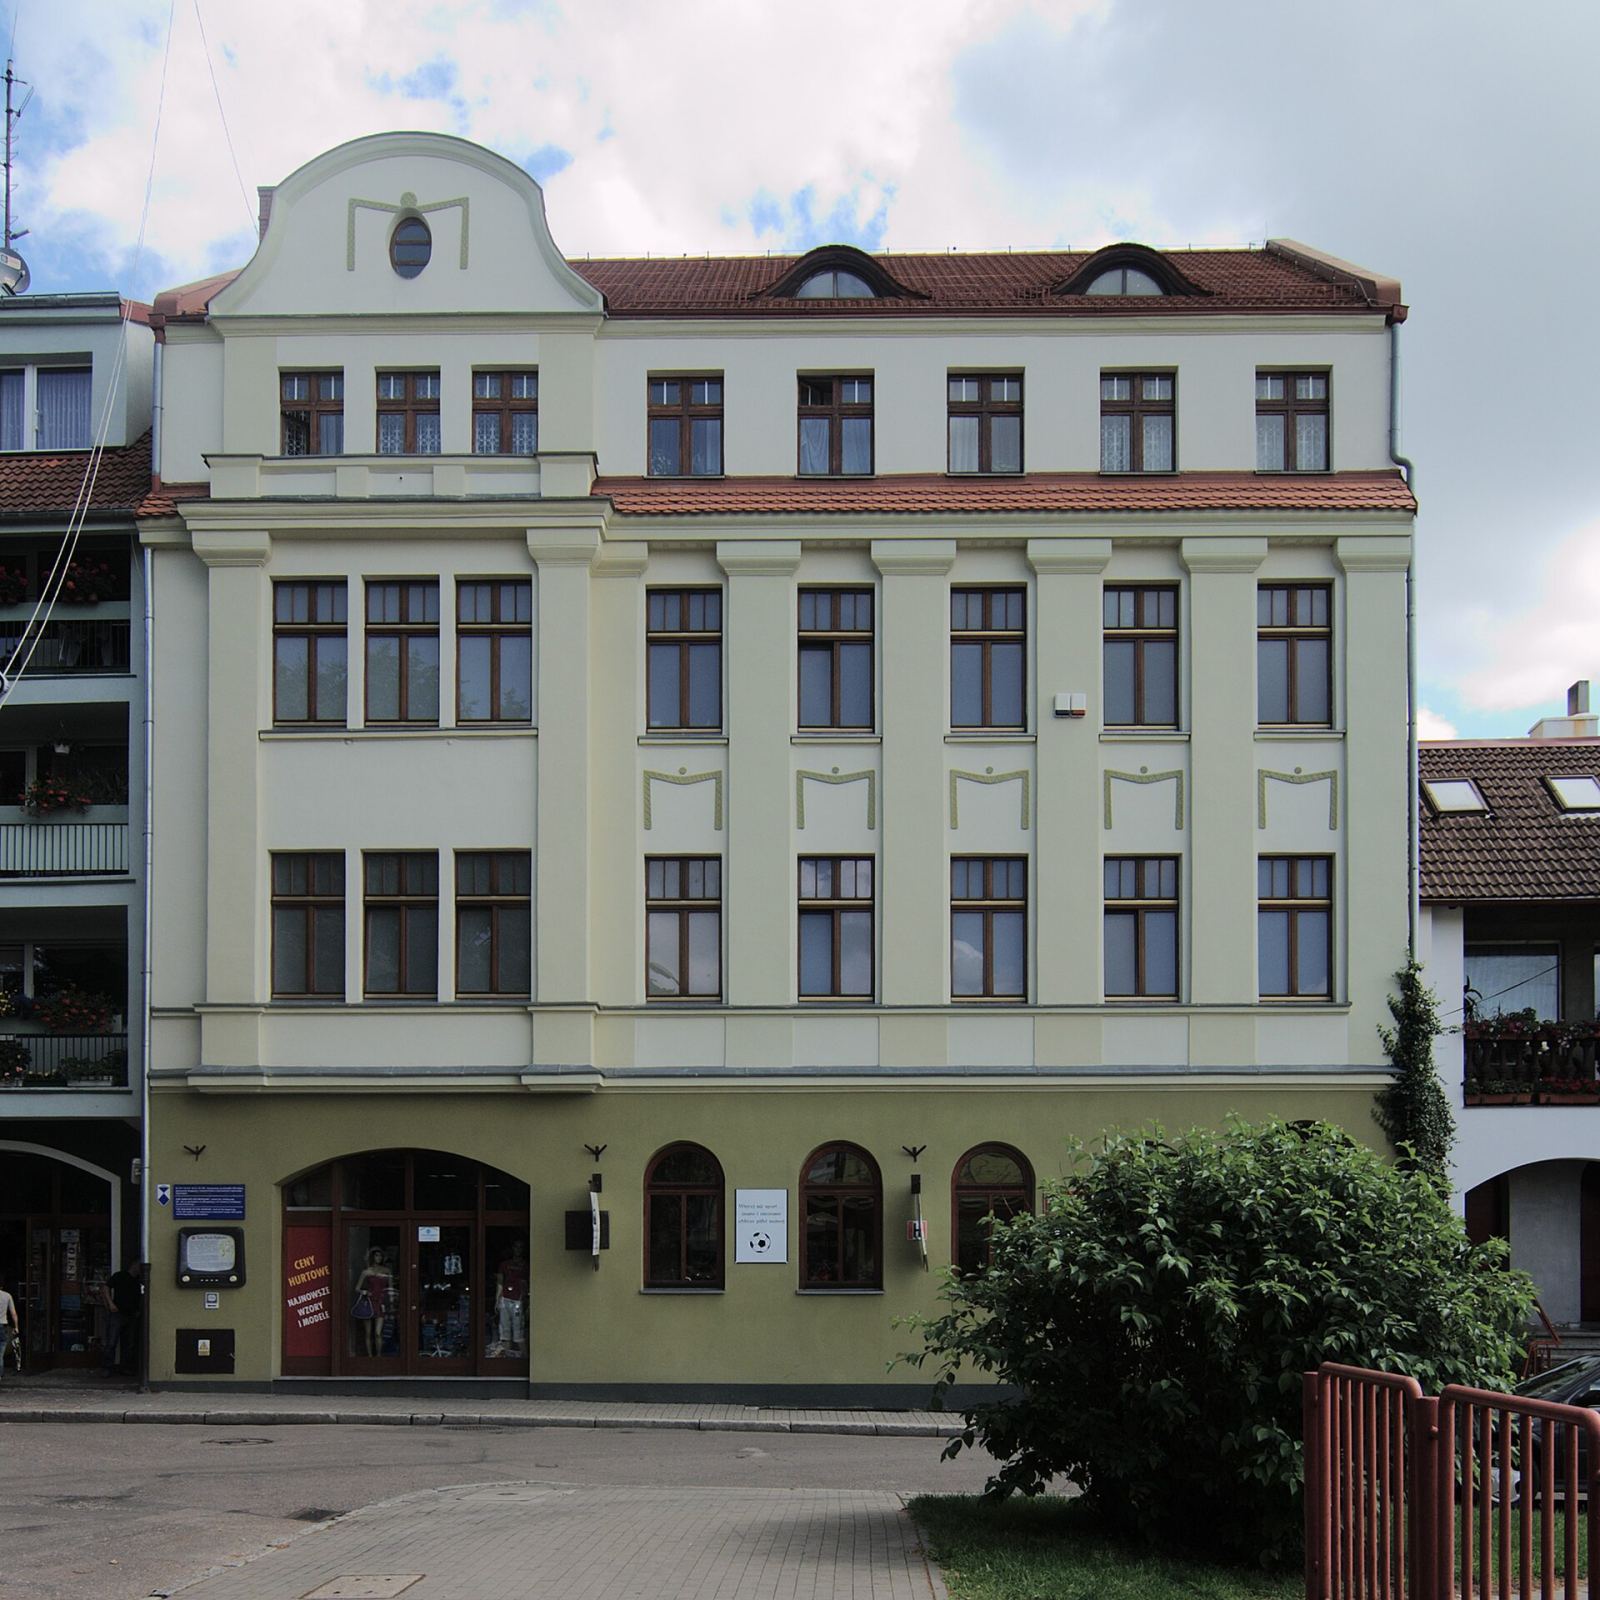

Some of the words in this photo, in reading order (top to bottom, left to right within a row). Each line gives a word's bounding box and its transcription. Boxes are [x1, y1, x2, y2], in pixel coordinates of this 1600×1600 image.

[294, 1255, 315, 1270] CENY
[288, 1265, 330, 1287] HURTOWE
[287, 1286, 331, 1307] NAJNOWSZE
[297, 1302, 323, 1316] WZORY
[298, 1320, 302, 1328] I
[303, 1310, 330, 1327] MODELE
